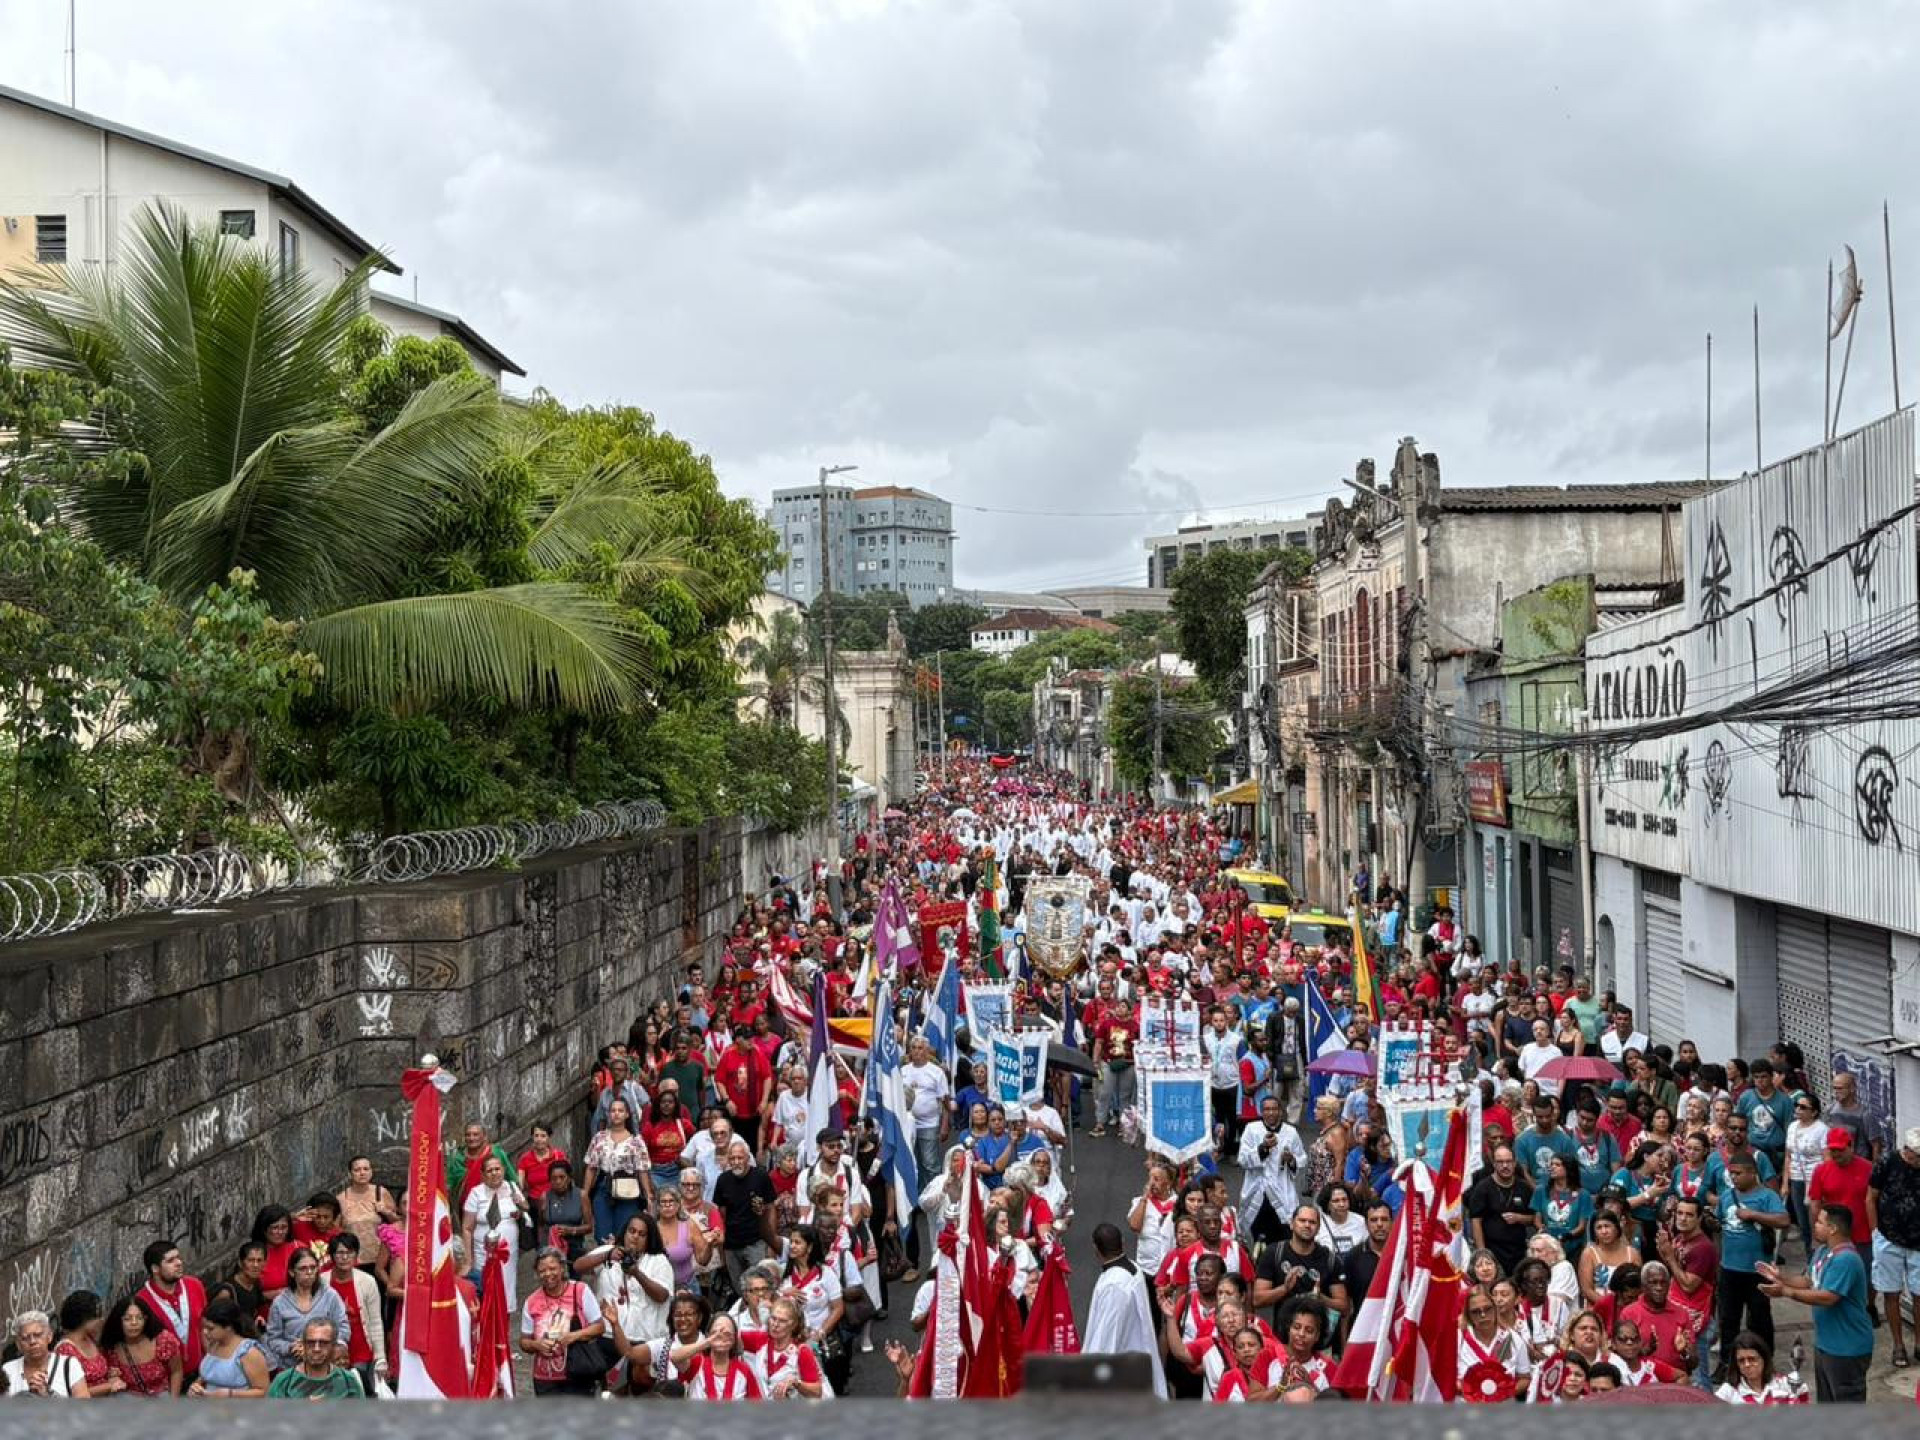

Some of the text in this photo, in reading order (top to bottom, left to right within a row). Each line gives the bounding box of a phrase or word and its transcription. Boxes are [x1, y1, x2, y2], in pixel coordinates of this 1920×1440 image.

[1592, 645, 1687, 721] ATACADÃO
[415, 1131, 430, 1284] APOSTOLADO DA ORAÇÃO
